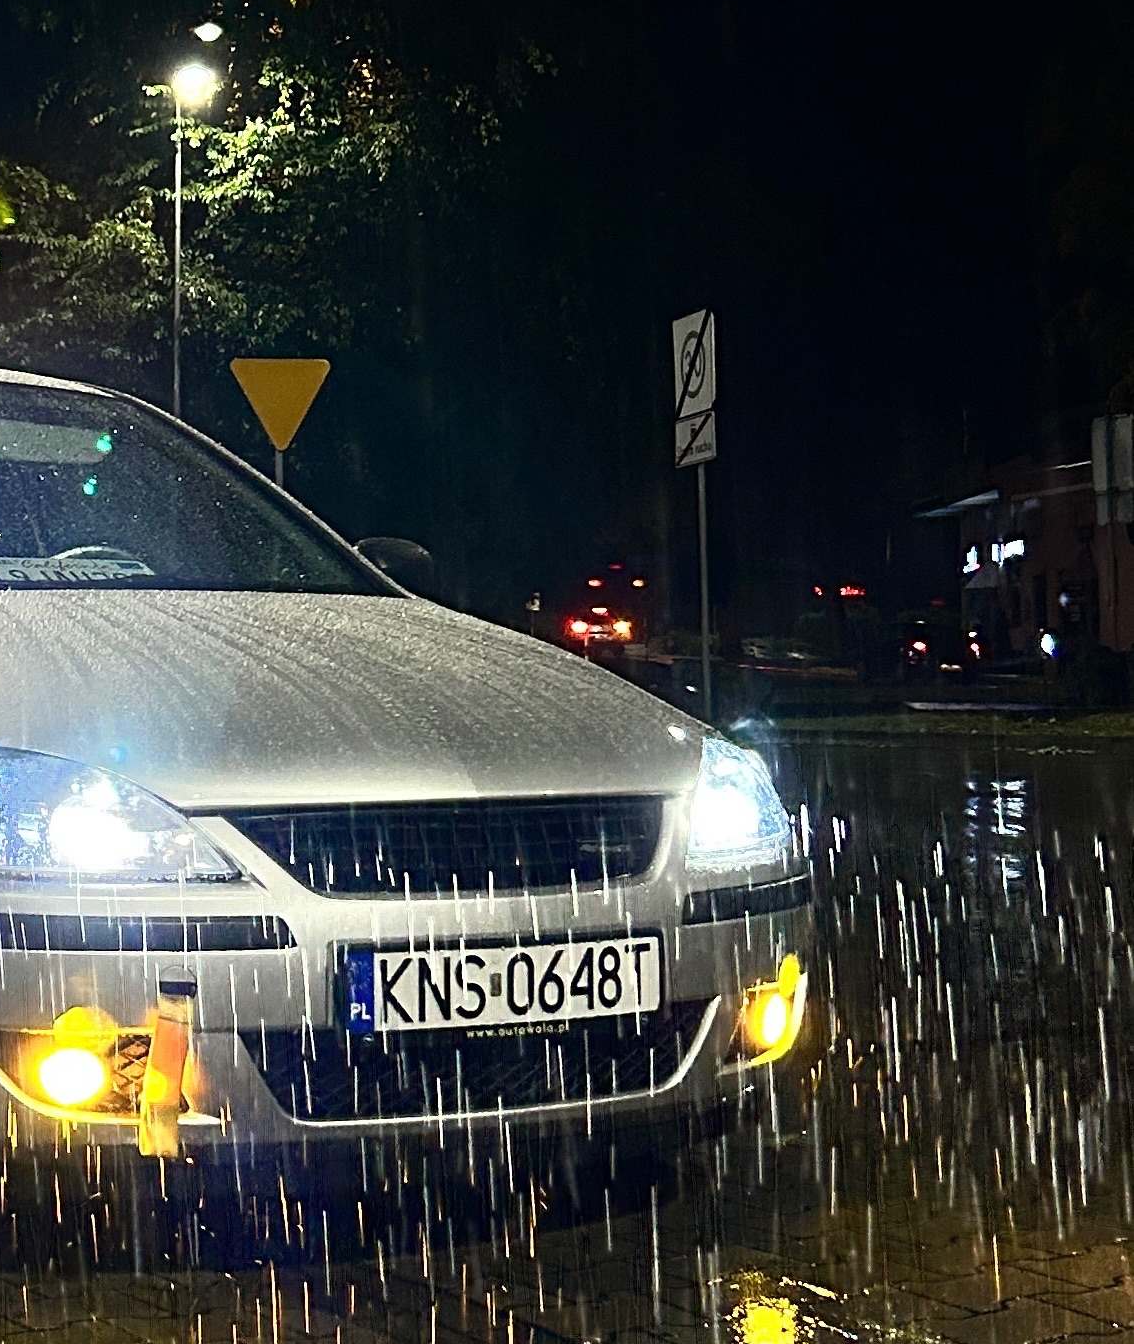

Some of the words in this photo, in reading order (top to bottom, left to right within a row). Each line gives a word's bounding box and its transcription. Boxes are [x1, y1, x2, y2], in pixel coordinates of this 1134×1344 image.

[379, 953, 487, 1024] KNS
[506, 942, 652, 1016] 0648T
[350, 1002, 371, 1020] PL
